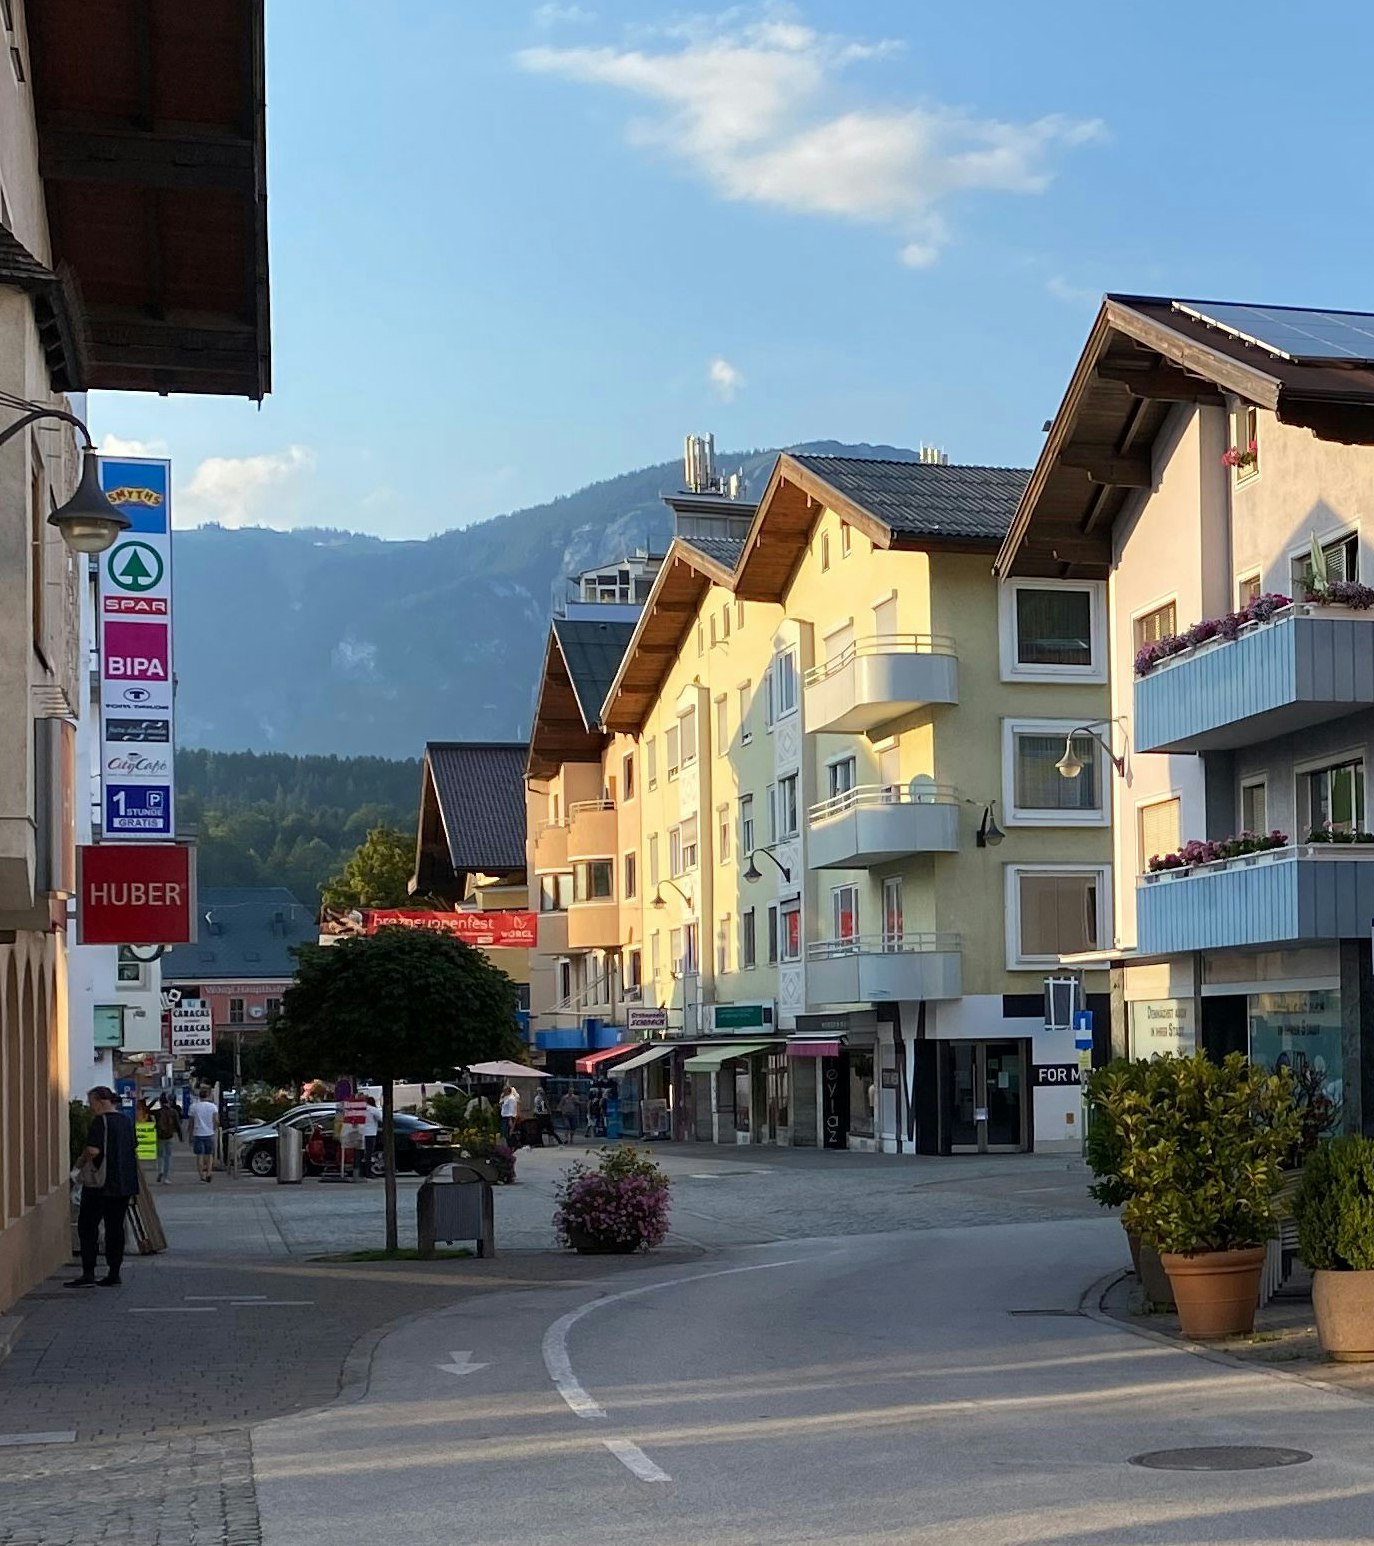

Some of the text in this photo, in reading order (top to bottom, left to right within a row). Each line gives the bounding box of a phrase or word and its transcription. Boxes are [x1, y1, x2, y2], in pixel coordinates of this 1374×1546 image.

[107, 489, 161, 505] SMYTHS
[105, 600, 166, 611] SPAR
[108, 656, 165, 677] BIPA
[112, 790, 164, 816] 1 STUNDE
[150, 794, 161, 806] P
[118, 818, 159, 827] GRATIS
[90, 883, 181, 906] HUBER
[173, 1009, 210, 1018] CARACAS
[173, 1024, 211, 1032] CARACAS
[173, 1039, 211, 1047] CARACAS
[1038, 1068, 1068, 1083] FOR
